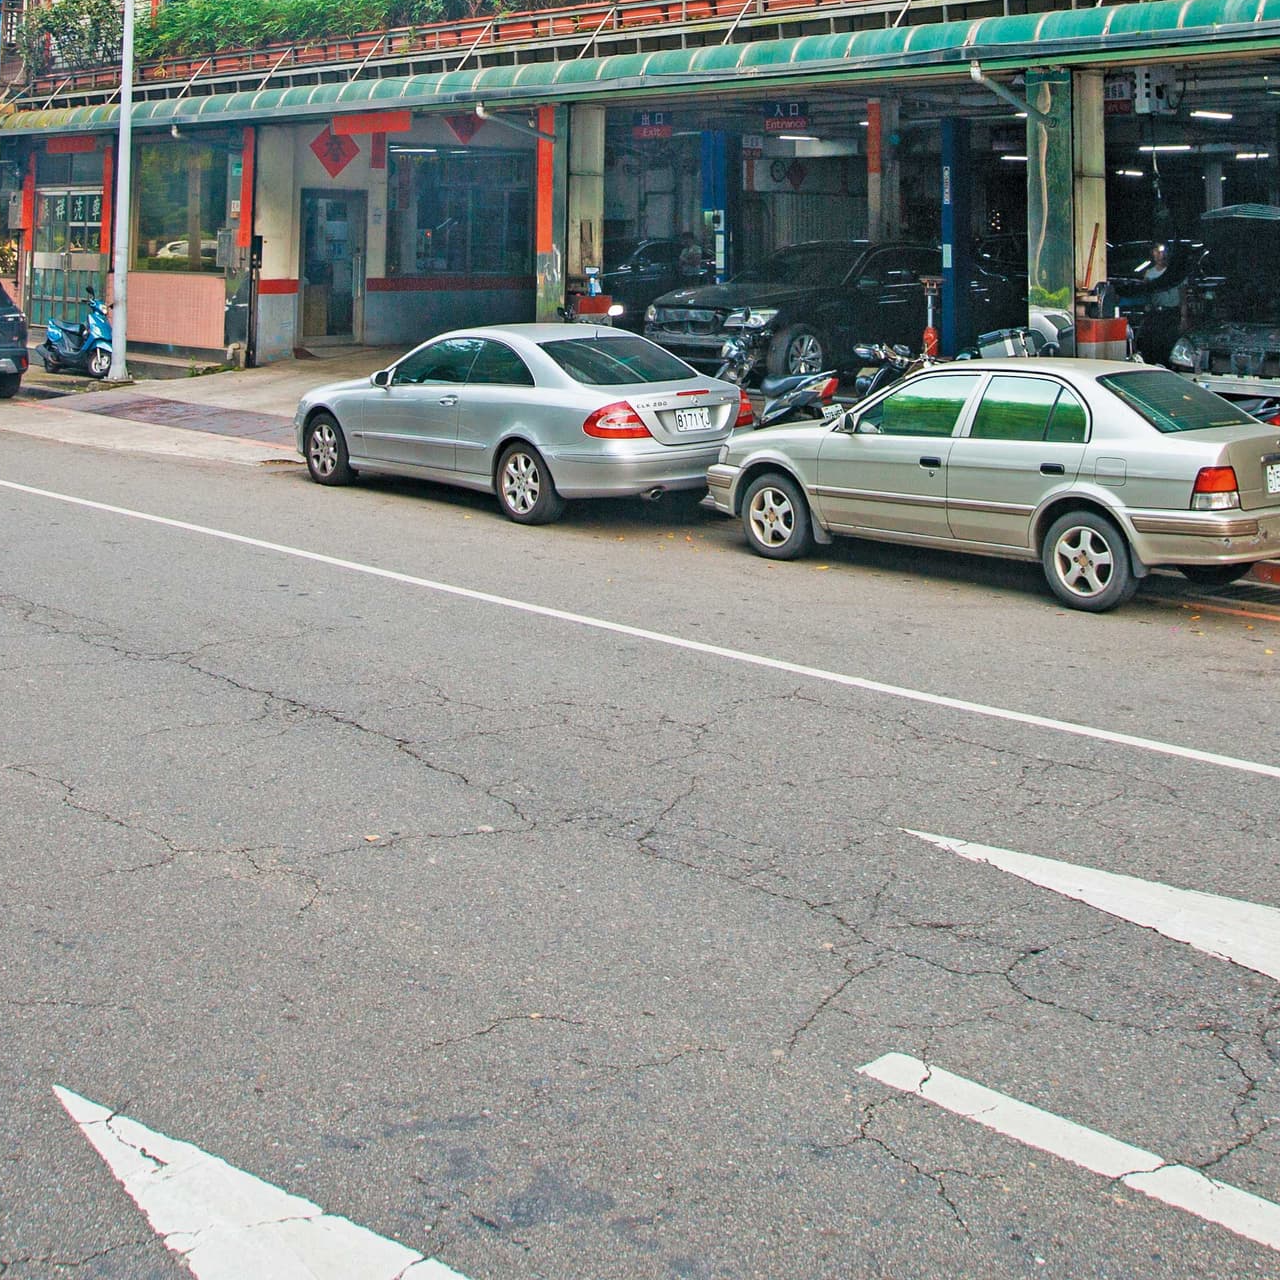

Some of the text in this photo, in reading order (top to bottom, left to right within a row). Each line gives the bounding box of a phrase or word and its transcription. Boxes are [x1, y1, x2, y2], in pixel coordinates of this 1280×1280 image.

[774, 103, 799, 117] 入口
[641, 112, 664, 126] 出口
[765, 120, 807, 130] Entrance
